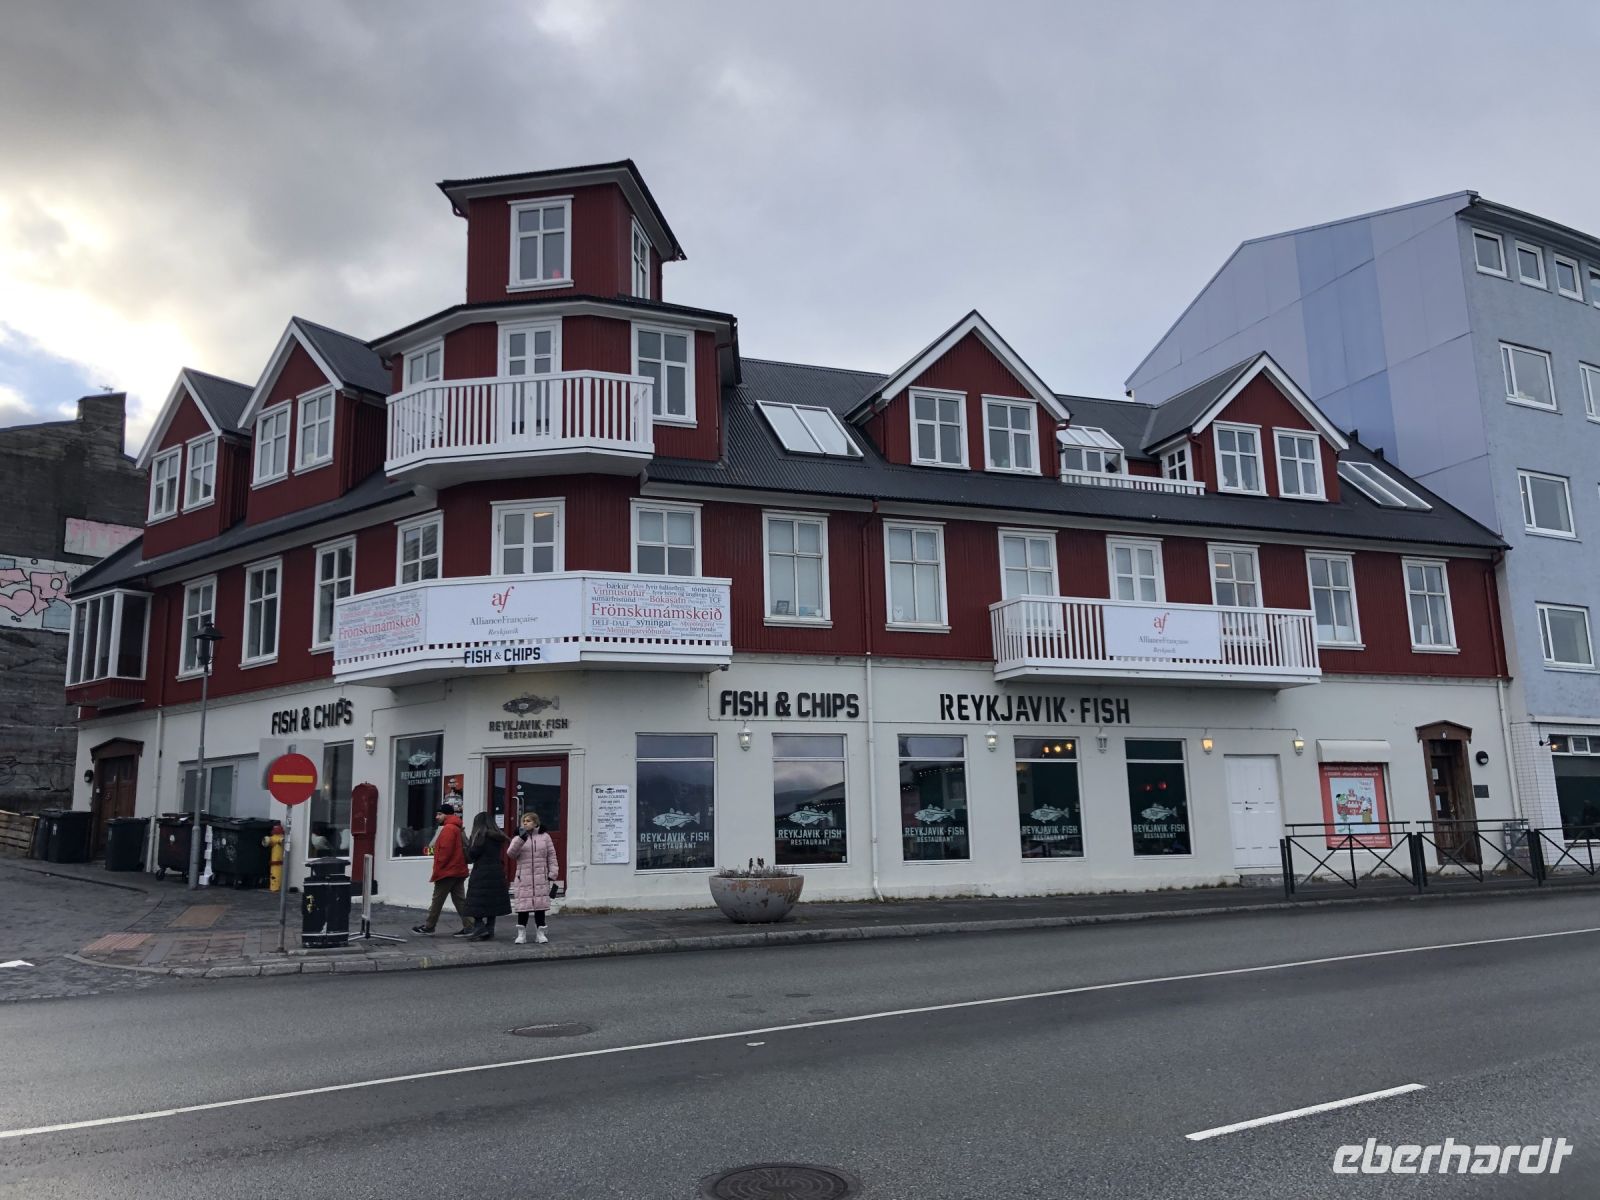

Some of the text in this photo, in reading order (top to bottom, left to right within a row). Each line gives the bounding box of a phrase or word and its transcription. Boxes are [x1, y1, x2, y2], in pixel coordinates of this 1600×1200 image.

[491, 585, 515, 613] af
[592, 602, 723, 621] Frönskunámskeið
[464, 647, 541, 664] FISH & CHIPS
[720, 690, 860, 718] FISH & CHIPS
[939, 693, 1131, 724] REYKJAVIK FISH
[271, 700, 353, 735] FISH & CHIPS
[489, 718, 569, 732] REYKJAVIK FISH
[503, 731, 554, 740] RESTAURANT
[778, 829, 842, 839] REYKJAVIK FISH
[904, 826, 965, 836] REYKJAVIK FISH
[1021, 825, 1078, 835] REYKJAVIK FISH
[1133, 824, 1186, 832] REYKJAVIK FISH
[641, 831, 710, 842] REYKJAVIK FISH
[653, 842, 697, 850] RESTAURANT
